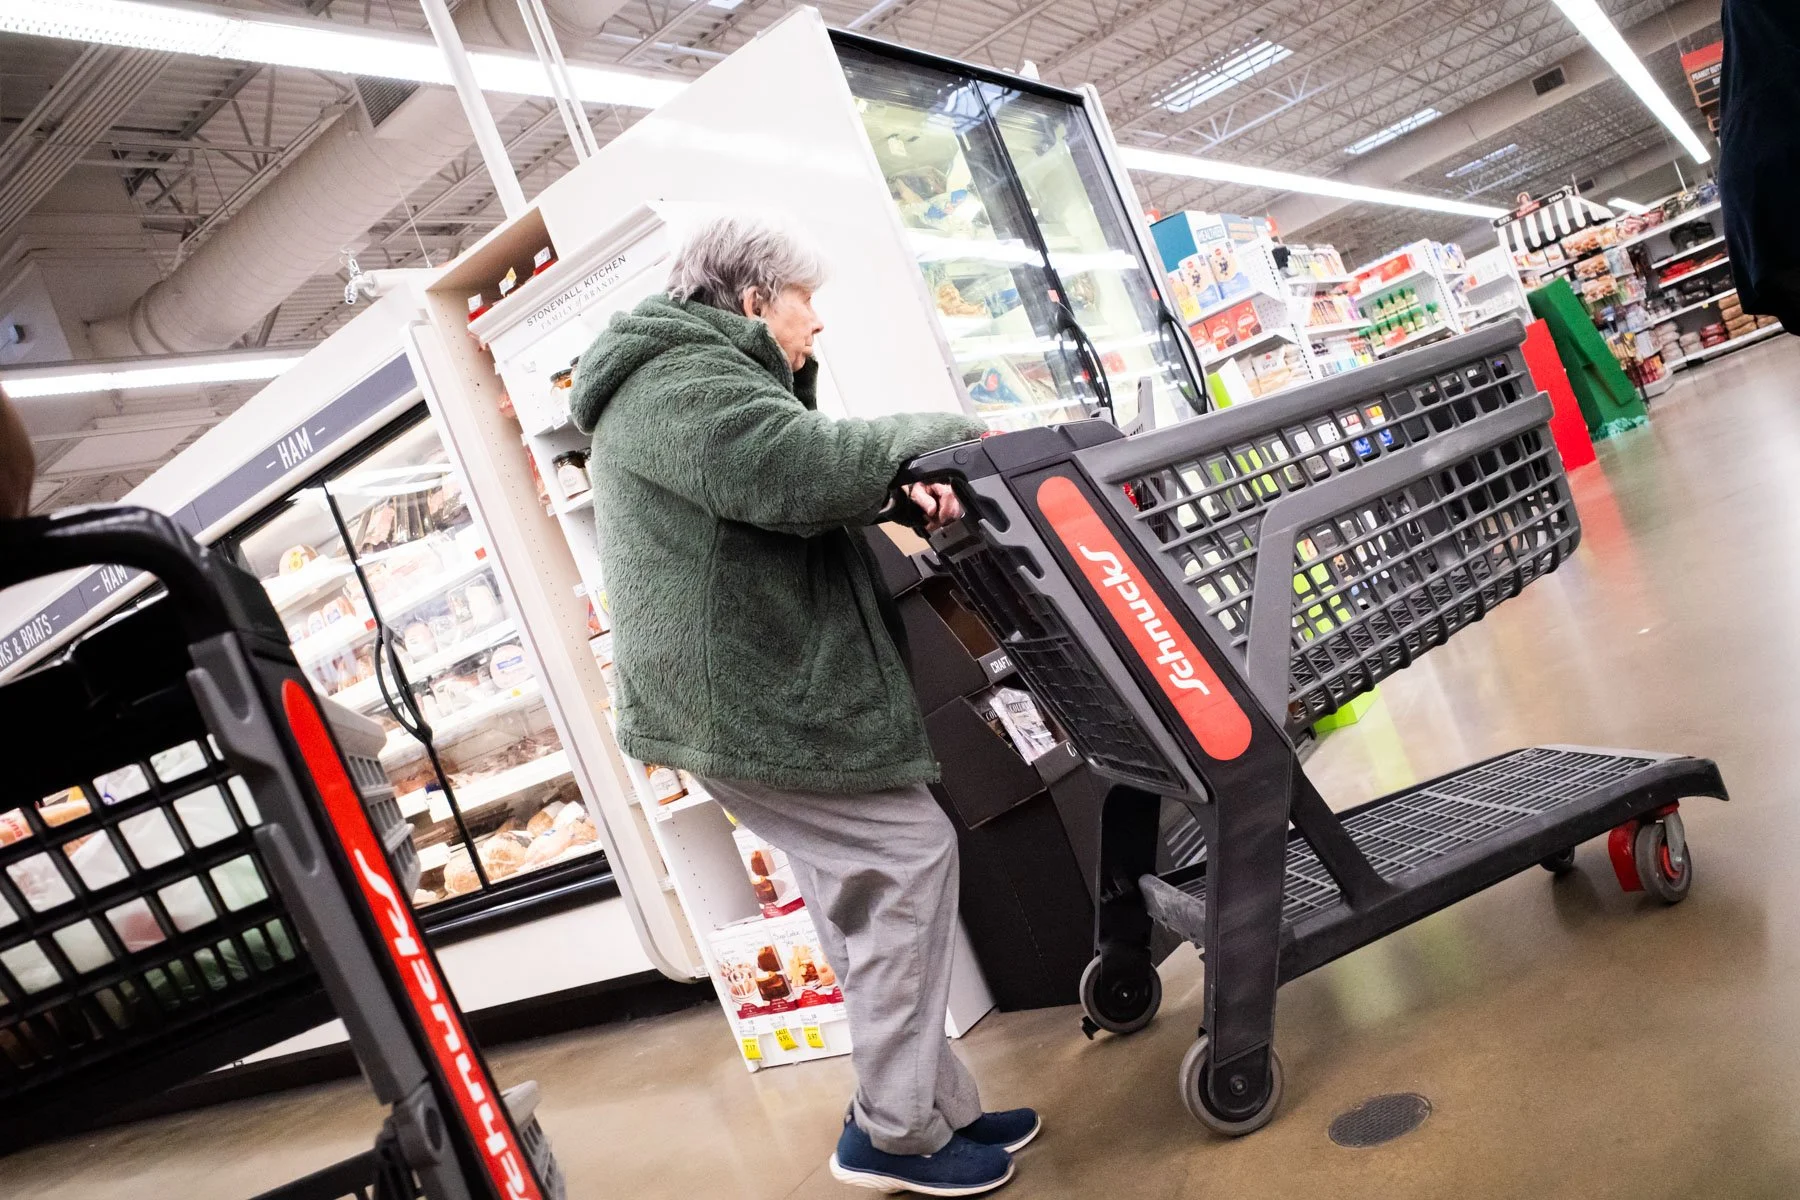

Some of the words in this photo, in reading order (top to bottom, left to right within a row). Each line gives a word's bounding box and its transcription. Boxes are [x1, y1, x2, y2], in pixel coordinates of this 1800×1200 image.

[526, 285, 583, 327] STONEWALL
[583, 254, 627, 288] KITCHEN
[541, 304, 573, 330] FAMILY
[584, 273, 621, 301] BRANDS
[277, 426, 314, 470] HAM
[100, 564, 128, 593] HAM
[12, 637, 23, 656] &
[20, 613, 52, 651] BRATS
[1079, 545, 1211, 695] Schnucks
[990, 656, 1013, 674] CRAFT
